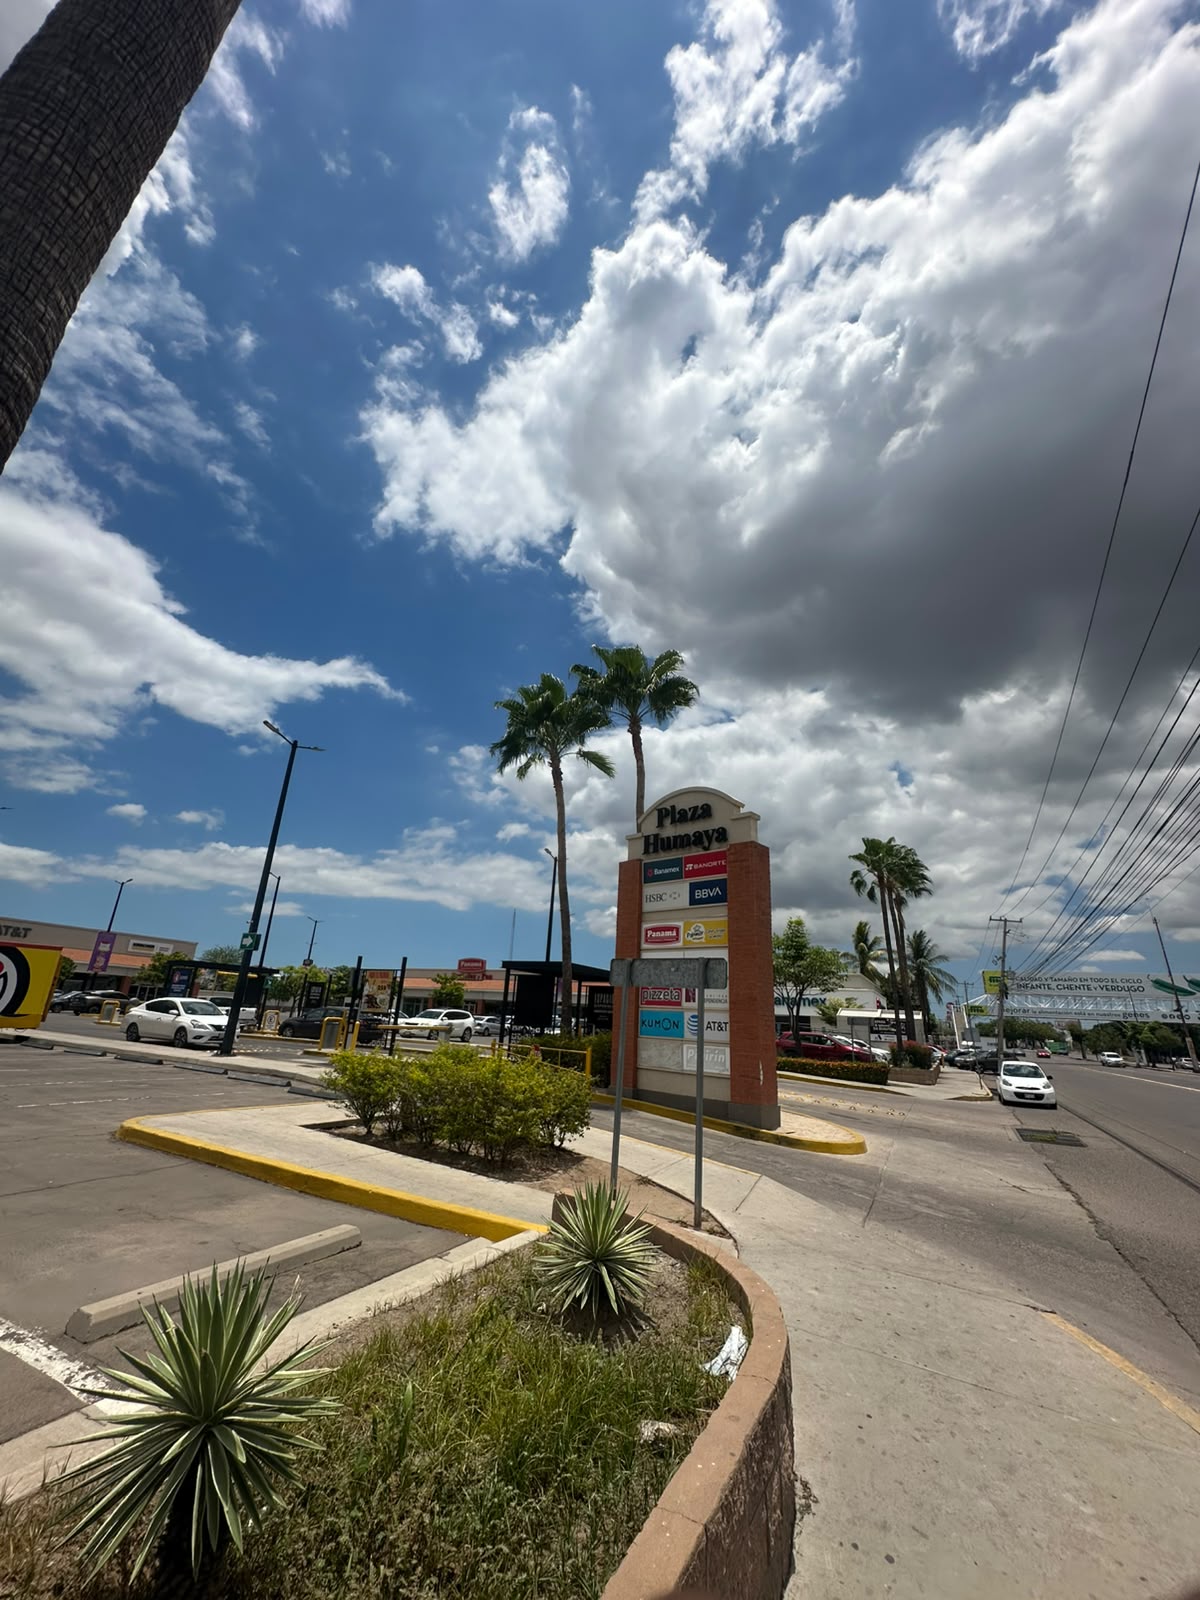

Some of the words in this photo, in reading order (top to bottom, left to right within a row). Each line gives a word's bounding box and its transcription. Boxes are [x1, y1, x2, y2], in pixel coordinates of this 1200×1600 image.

[656, 803, 712, 828] Plaza
[642, 827, 728, 855] Humaya
[654, 866, 679, 875] Banamex
[694, 860, 726, 870] BANORTE
[645, 892, 667, 903] HSBC
[695, 887, 722, 899] BBVA
[647, 928, 677, 938] Panamá
[1050, 975, 1078, 983] TAMAÑO
[1056, 983, 1091, 991] CHENTE
[1098, 984, 1145, 992] VERDUGO
[642, 987, 680, 1004] pizzeta
[775, 996, 827, 1007] anamex
[1004, 1007, 1031, 1016] ejorar
[1122, 1012, 1151, 1020] genes
[641, 1017, 680, 1031] KUMON
[706, 1020, 728, 1032] AT&T
